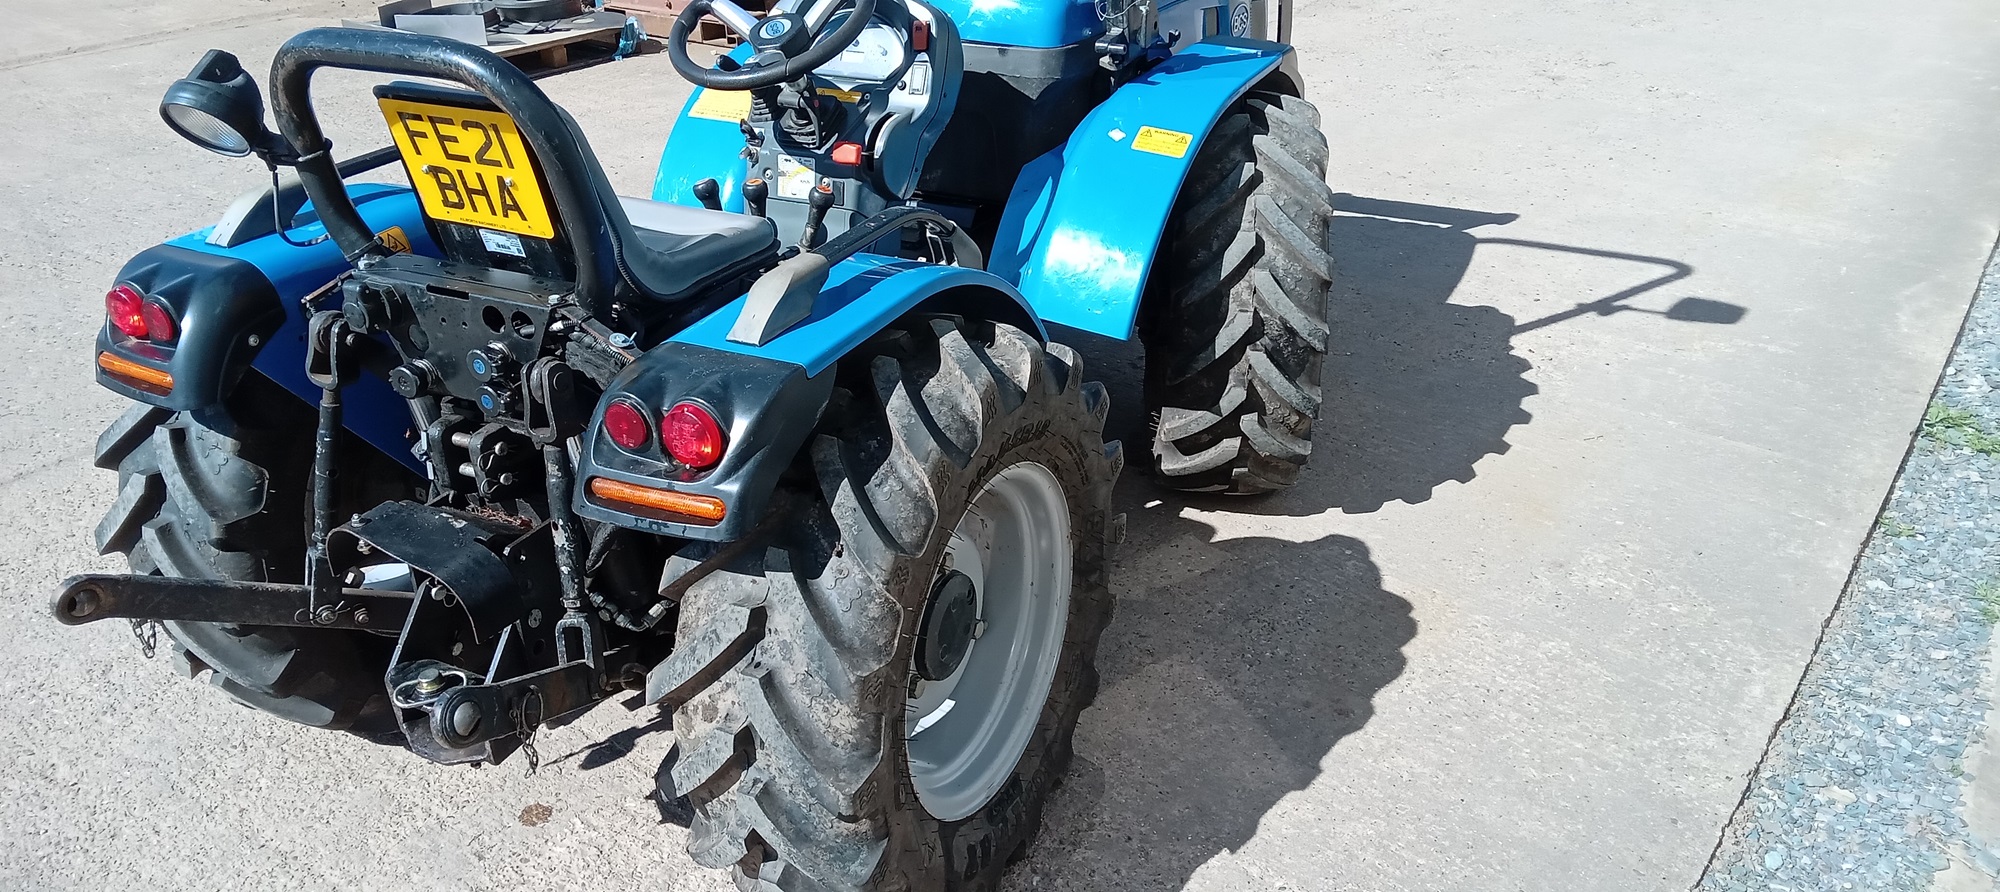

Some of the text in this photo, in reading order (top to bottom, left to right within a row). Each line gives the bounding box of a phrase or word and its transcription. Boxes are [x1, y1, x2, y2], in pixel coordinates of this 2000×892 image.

[1234, 12, 1248, 32] BCS
[396, 111, 515, 169] FE21
[1154, 130, 1180, 138] WARNING
[427, 164, 529, 222] BHA
